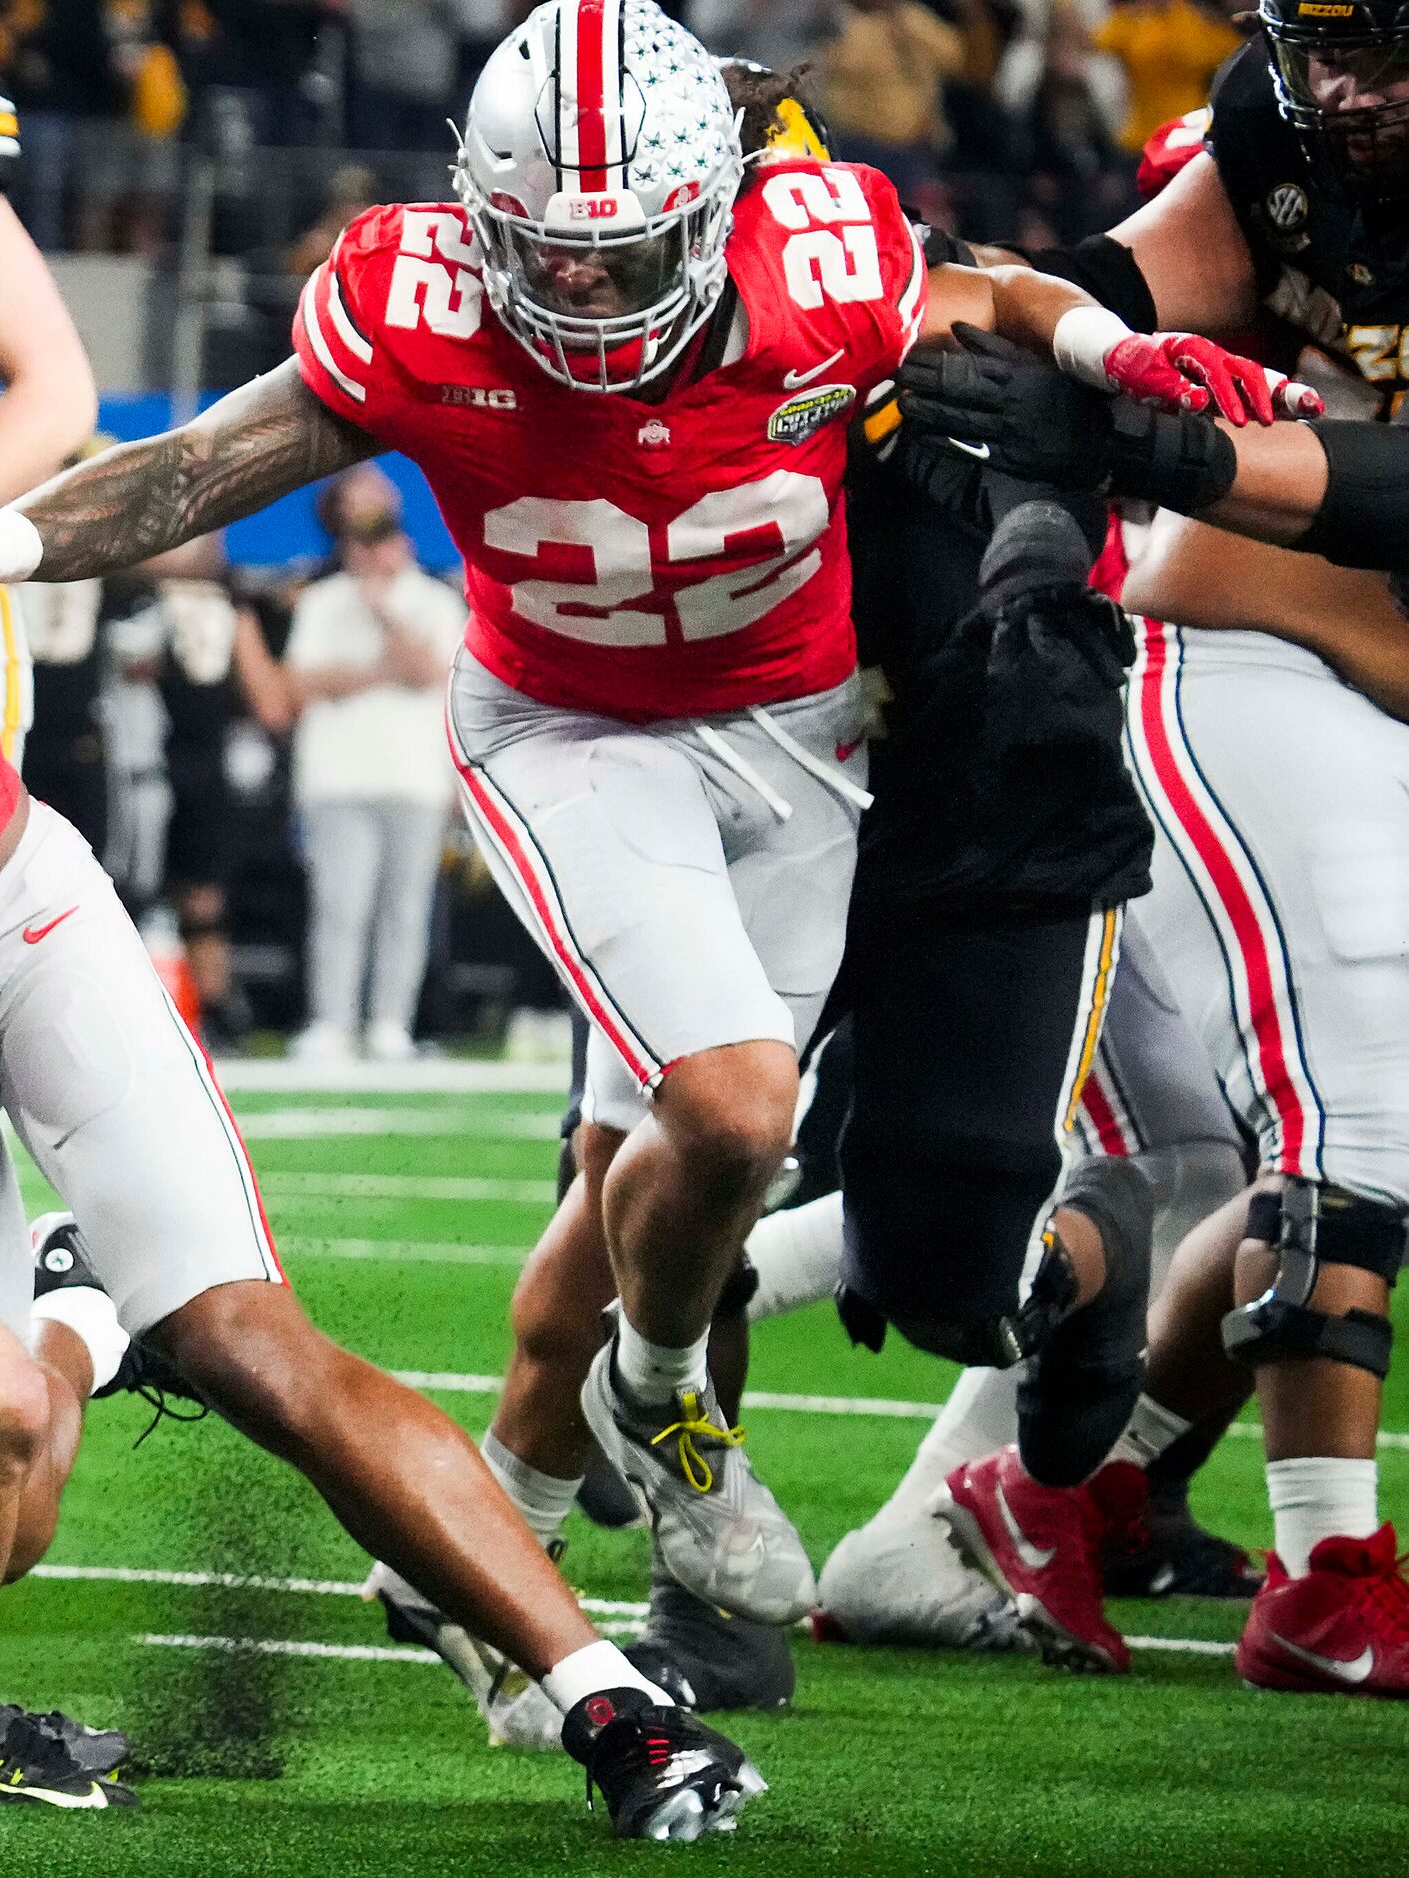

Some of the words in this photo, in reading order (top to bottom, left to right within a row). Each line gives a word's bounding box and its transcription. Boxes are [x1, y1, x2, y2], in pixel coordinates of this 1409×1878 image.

[385, 209, 486, 341] 22
[762, 167, 884, 311] 22
[484, 468, 831, 648] 22
